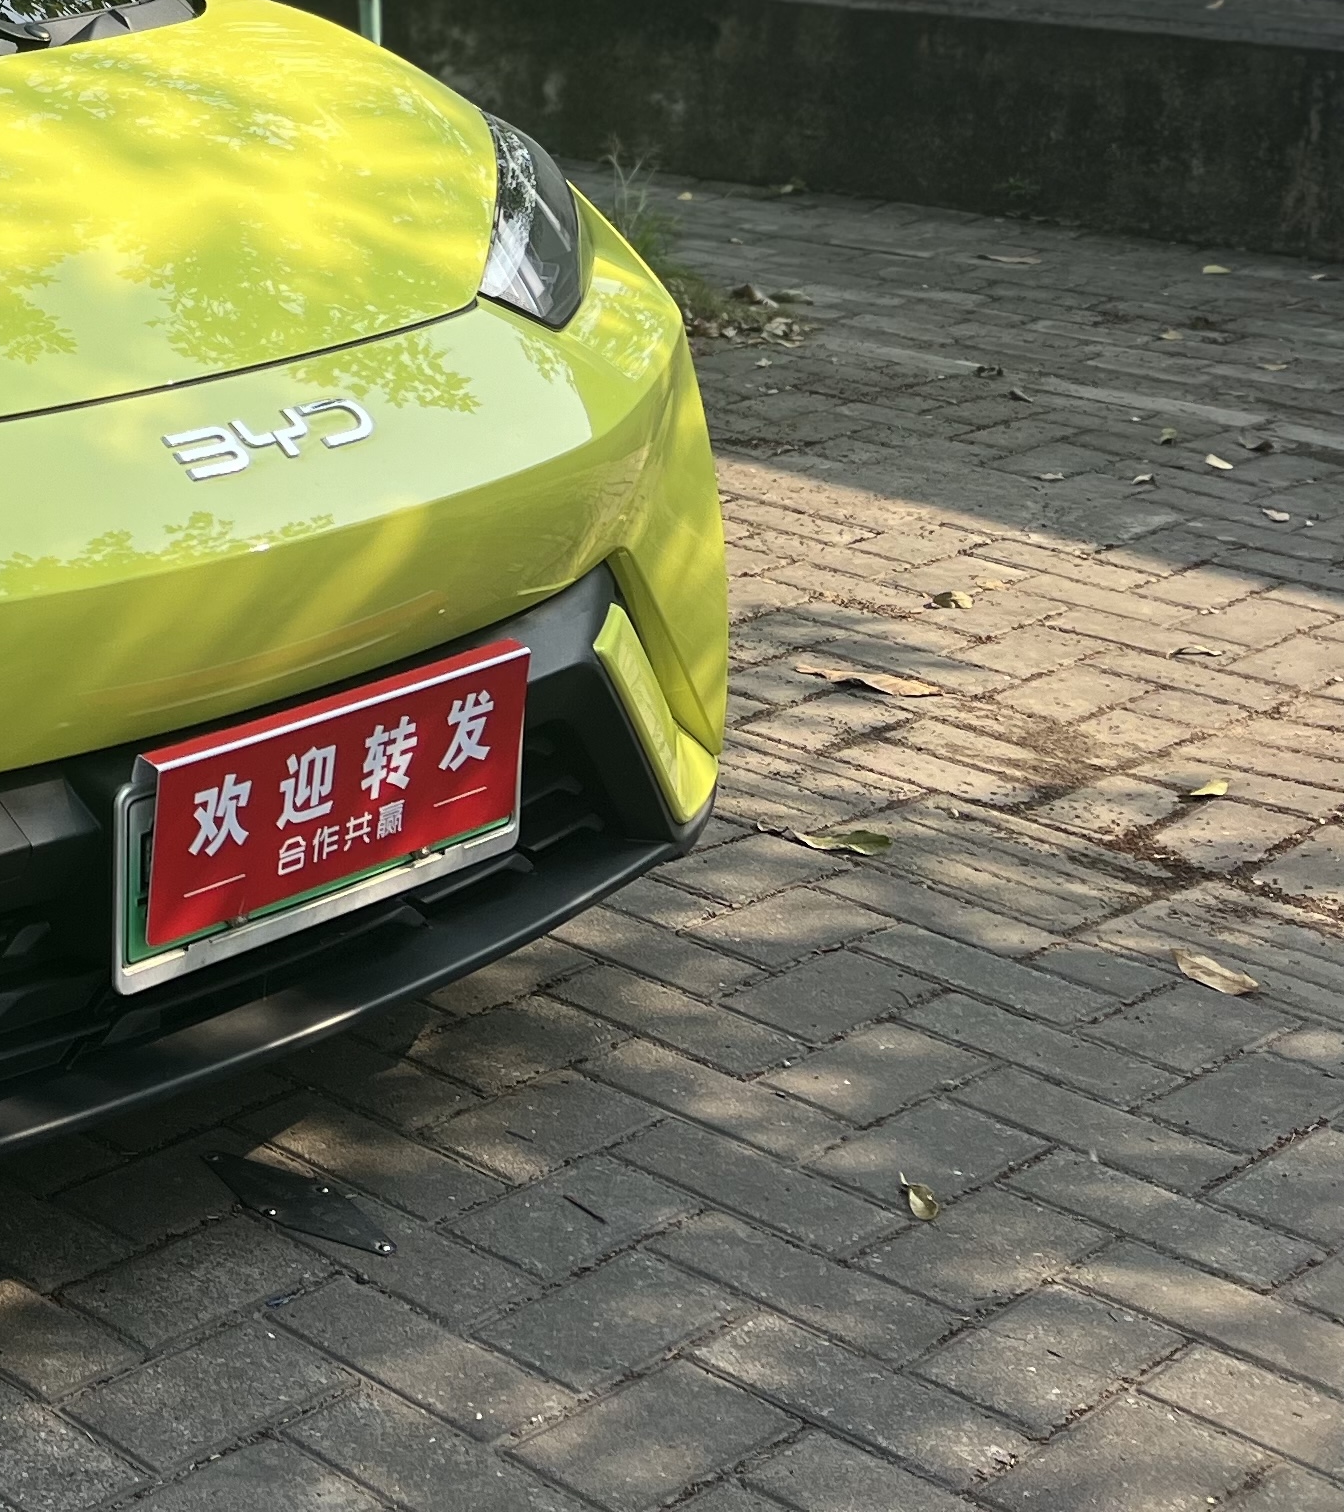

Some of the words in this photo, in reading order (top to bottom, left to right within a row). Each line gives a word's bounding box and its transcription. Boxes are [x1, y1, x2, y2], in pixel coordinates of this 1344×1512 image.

[161, 398, 374, 482] BYD
[188, 690, 494, 857] 欢迎转发
[277, 799, 405, 876] 合作共赢
